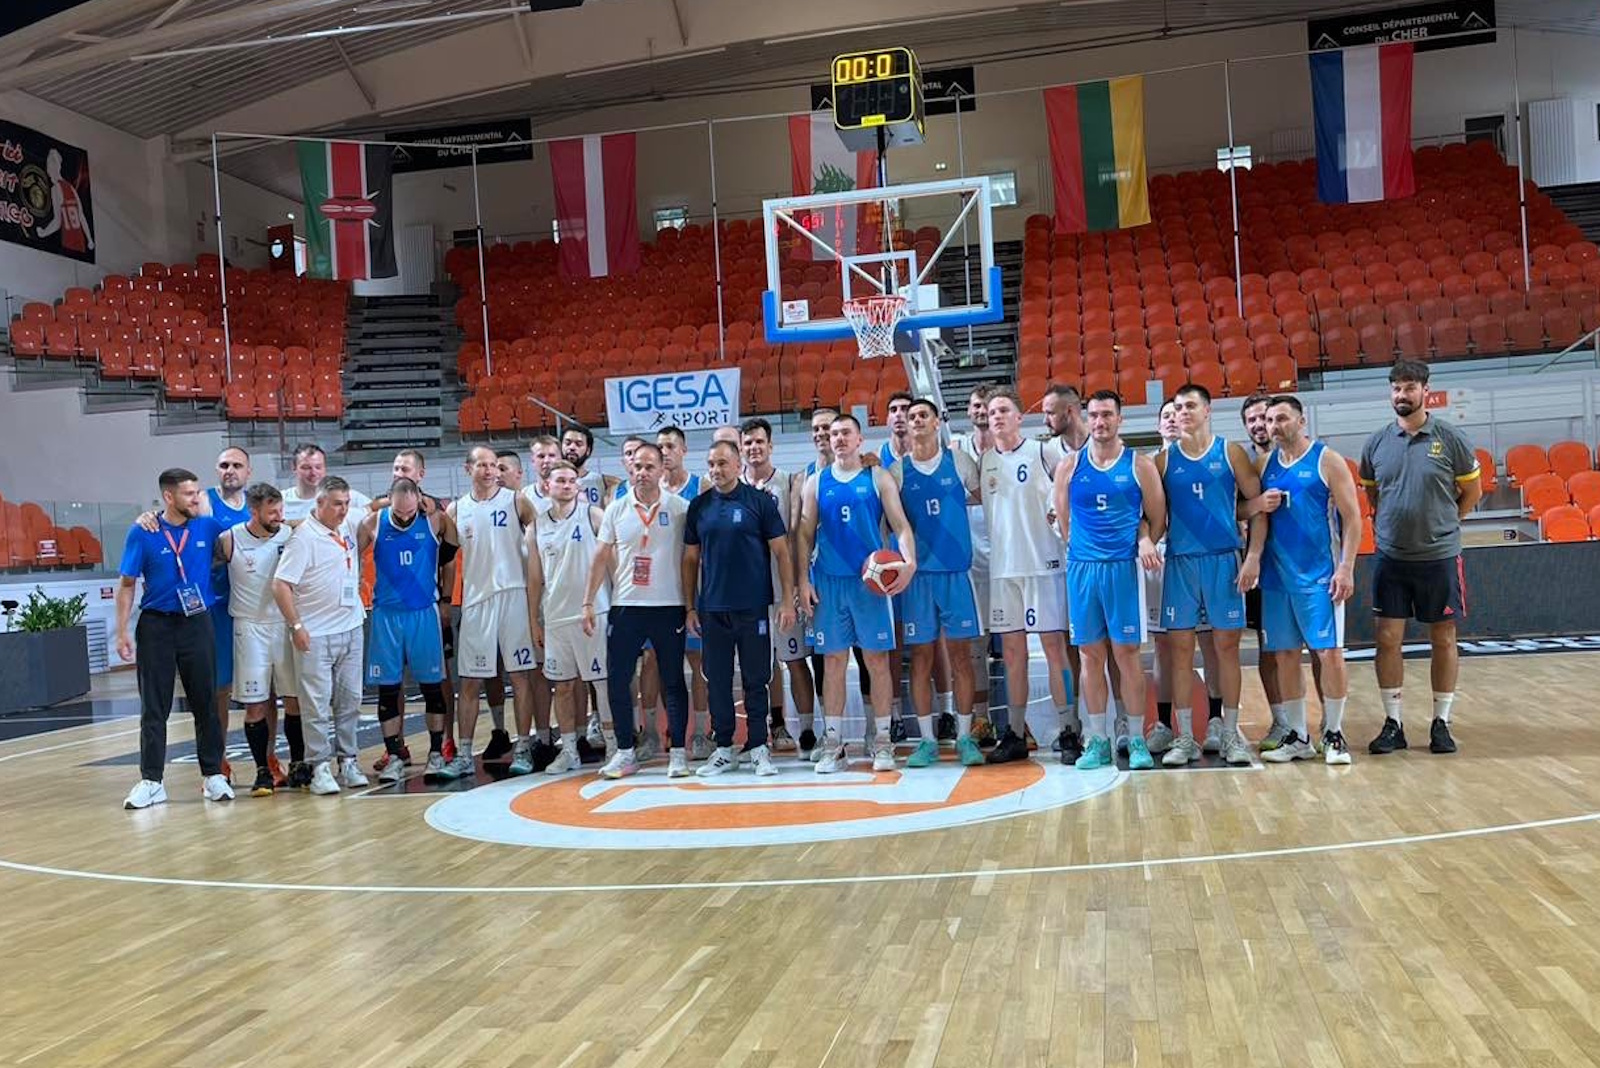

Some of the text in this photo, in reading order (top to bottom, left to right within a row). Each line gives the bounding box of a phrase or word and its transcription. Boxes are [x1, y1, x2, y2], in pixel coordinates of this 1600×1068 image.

[1343, 12, 1459, 35] CONSEIL DÉPARTEMENTAL
[1375, 26, 1428, 44] DU CHER
[618, 373, 729, 413] IGESA
[672, 409, 730, 427] SPORT
[1017, 464, 1028, 483] 6
[584, 487, 599, 503] 16
[1192, 482, 1204, 500] 4
[925, 498, 941, 516] 13
[1096, 494, 1108, 511] 5
[490, 510, 508, 527] 12
[841, 505, 851, 523] 9
[571, 525, 582, 542] 4
[399, 551, 412, 566] 10
[1025, 608, 1036, 627] 6
[1166, 606, 1176, 622] 4
[788, 637, 798, 655] 9
[816, 631, 825, 646] 9
[513, 648, 532, 666] 12
[590, 658, 601, 674] 4
